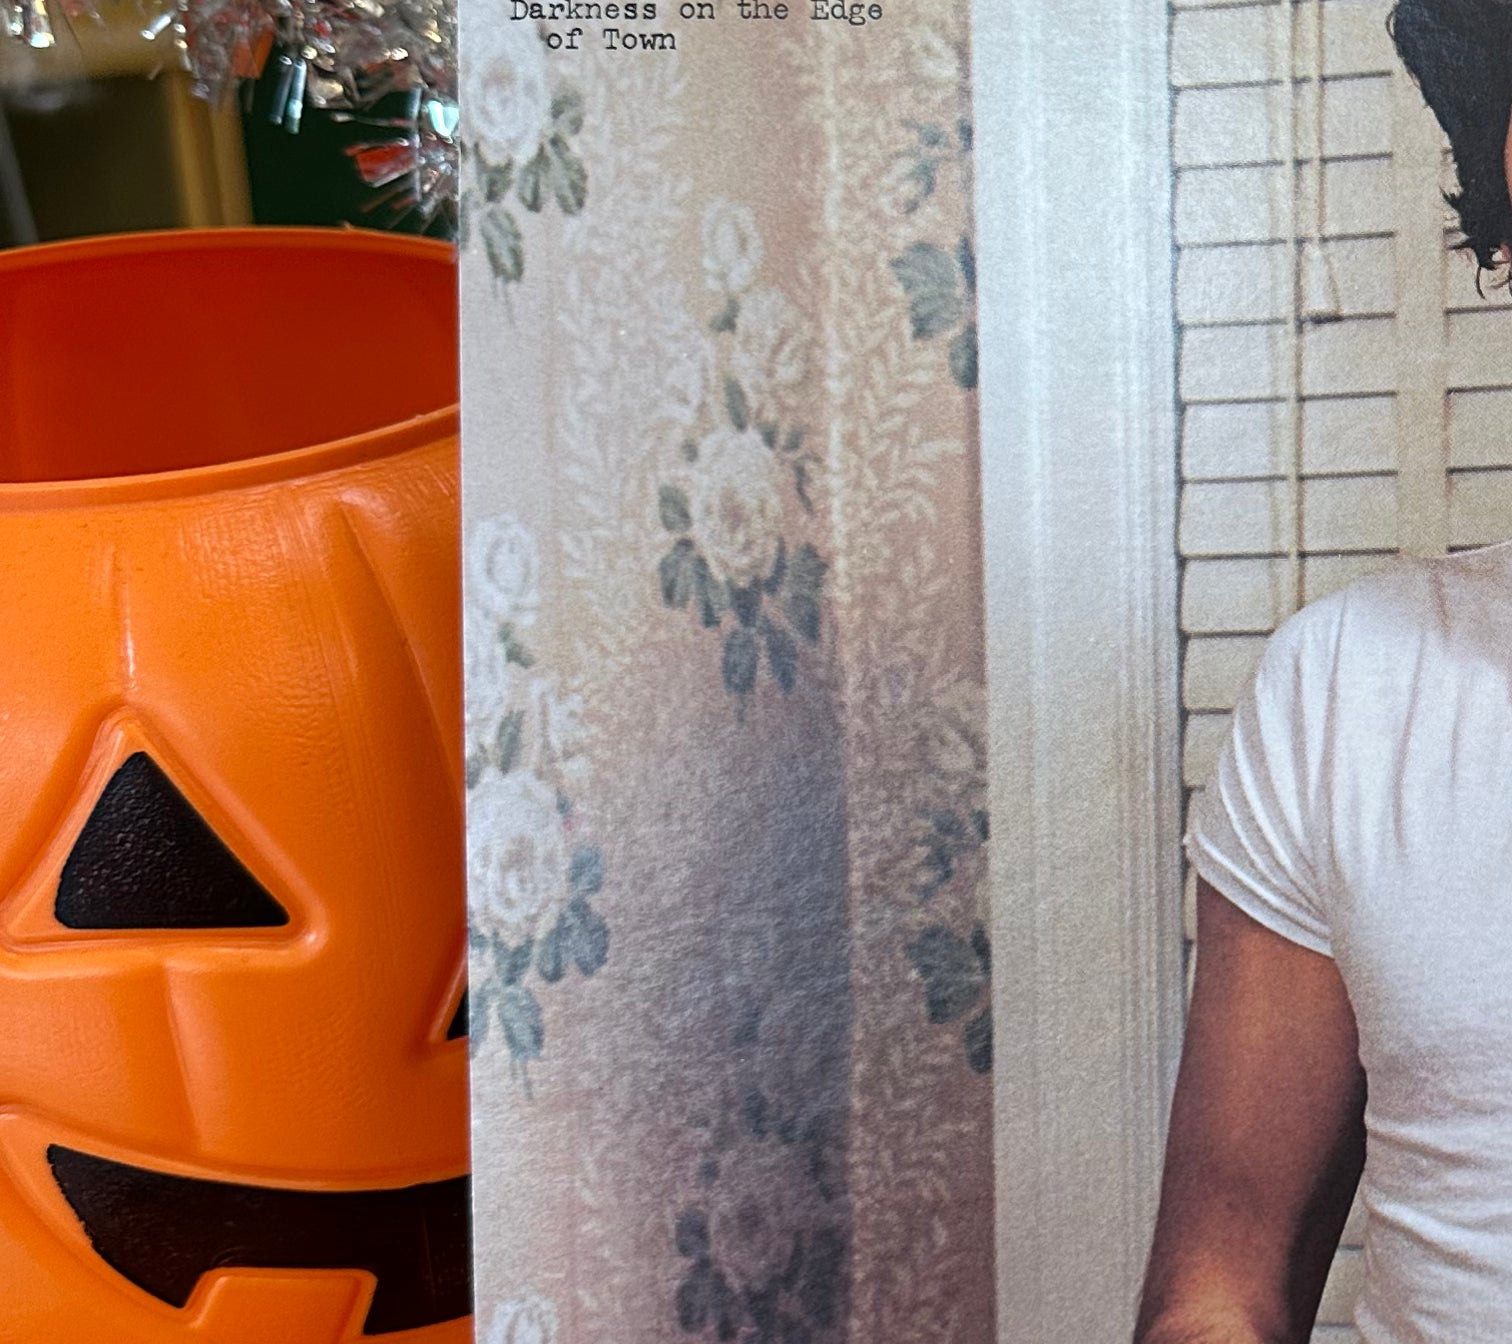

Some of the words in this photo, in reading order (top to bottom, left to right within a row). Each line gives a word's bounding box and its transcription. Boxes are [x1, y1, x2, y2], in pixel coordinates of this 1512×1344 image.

[680, 0, 715, 20] on
[547, 28, 583, 51] of
[604, 29, 676, 51] Town
